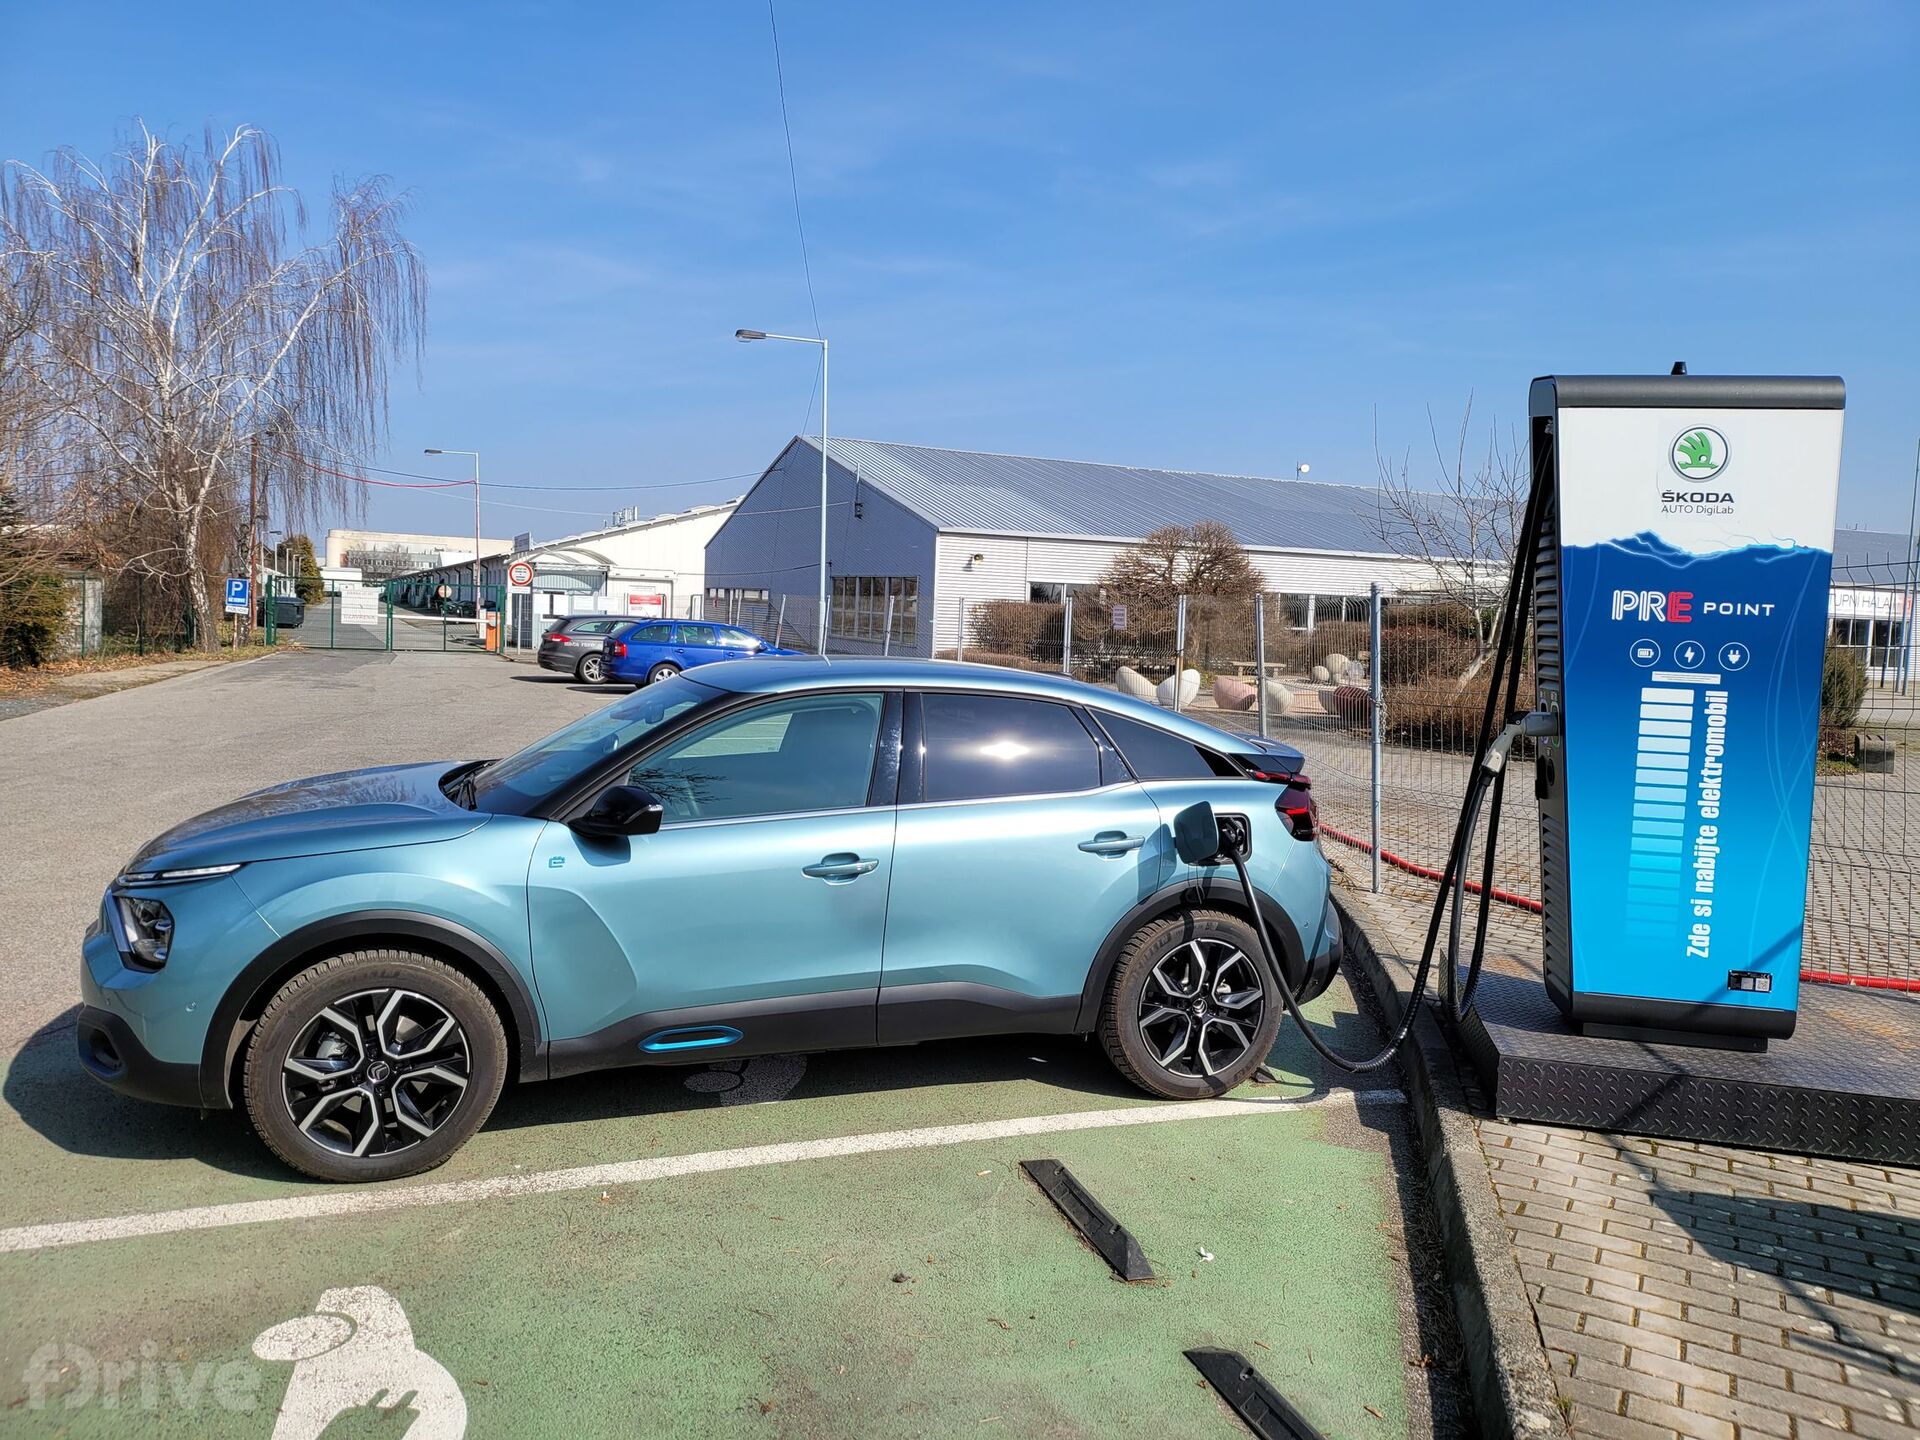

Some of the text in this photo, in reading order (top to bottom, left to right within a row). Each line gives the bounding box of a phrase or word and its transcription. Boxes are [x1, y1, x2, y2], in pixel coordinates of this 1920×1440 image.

[1661, 490, 1735, 504] ŠKODA
[1661, 505, 1735, 516] AUTO DigiLab
[231, 581, 244, 596] P
[1611, 589, 1775, 623] PRE POINT
[1686, 690, 1729, 959] Zde si nabijte elektromobil
